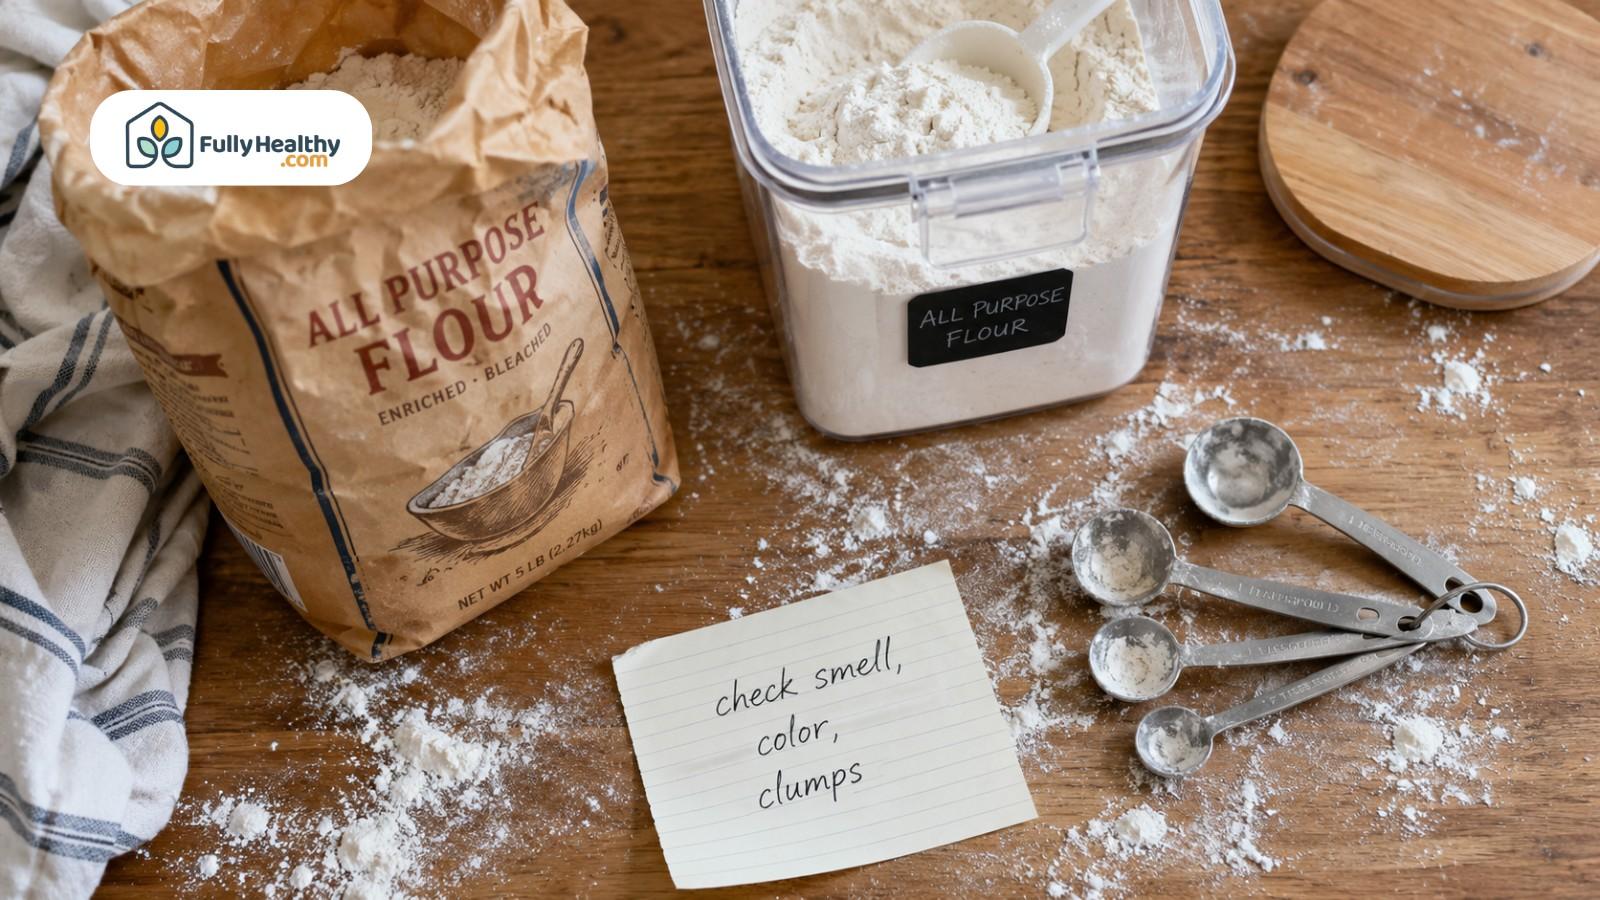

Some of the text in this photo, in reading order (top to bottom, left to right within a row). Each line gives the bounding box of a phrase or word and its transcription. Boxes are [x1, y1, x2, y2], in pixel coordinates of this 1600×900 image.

[308, 294, 380, 348] ALL
[384, 201, 545, 315] PURPOSE
[919, 286, 1065, 329] ALL PURPOSE
[354, 264, 545, 396] FLOUR
[946, 318, 1029, 348] FLOUR
[378, 322, 552, 426] ENRICHED BLEACHED
[457, 518, 603, 610] NET WT 5 LB (2.27kg)
[715, 635, 902, 717] check smell,
[757, 713, 838, 756] color,
[758, 762, 863, 809] clumps
